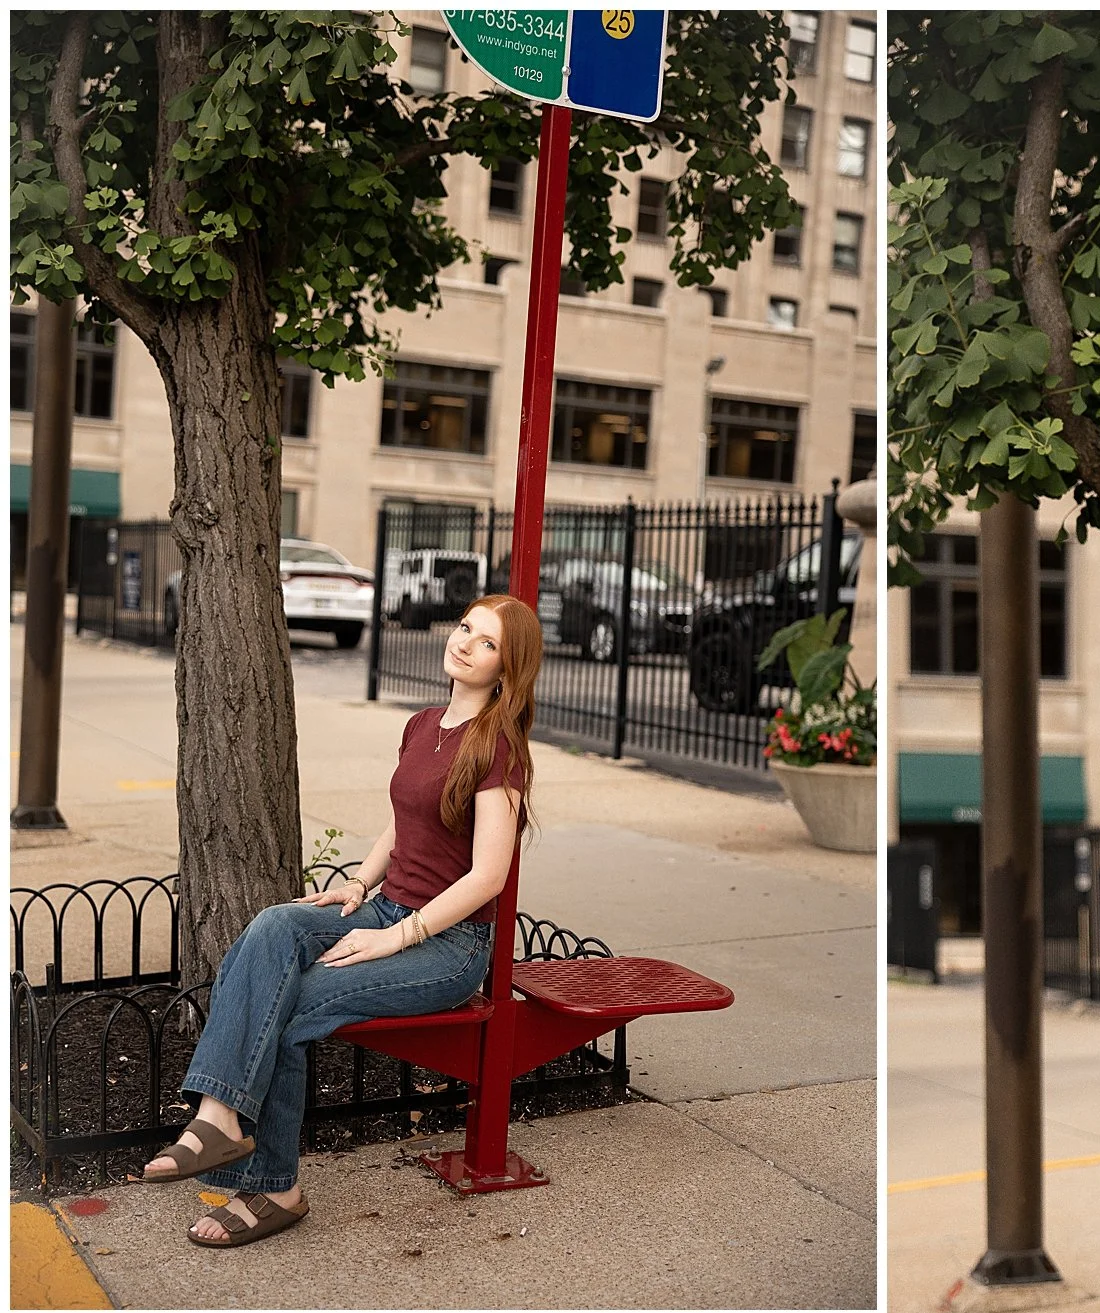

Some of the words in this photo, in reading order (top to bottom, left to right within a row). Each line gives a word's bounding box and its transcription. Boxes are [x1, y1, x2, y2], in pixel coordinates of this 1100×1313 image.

[606, 10, 631, 33] 25
[477, 34, 557, 59] www.indygo.net
[513, 65, 543, 82] 10129
